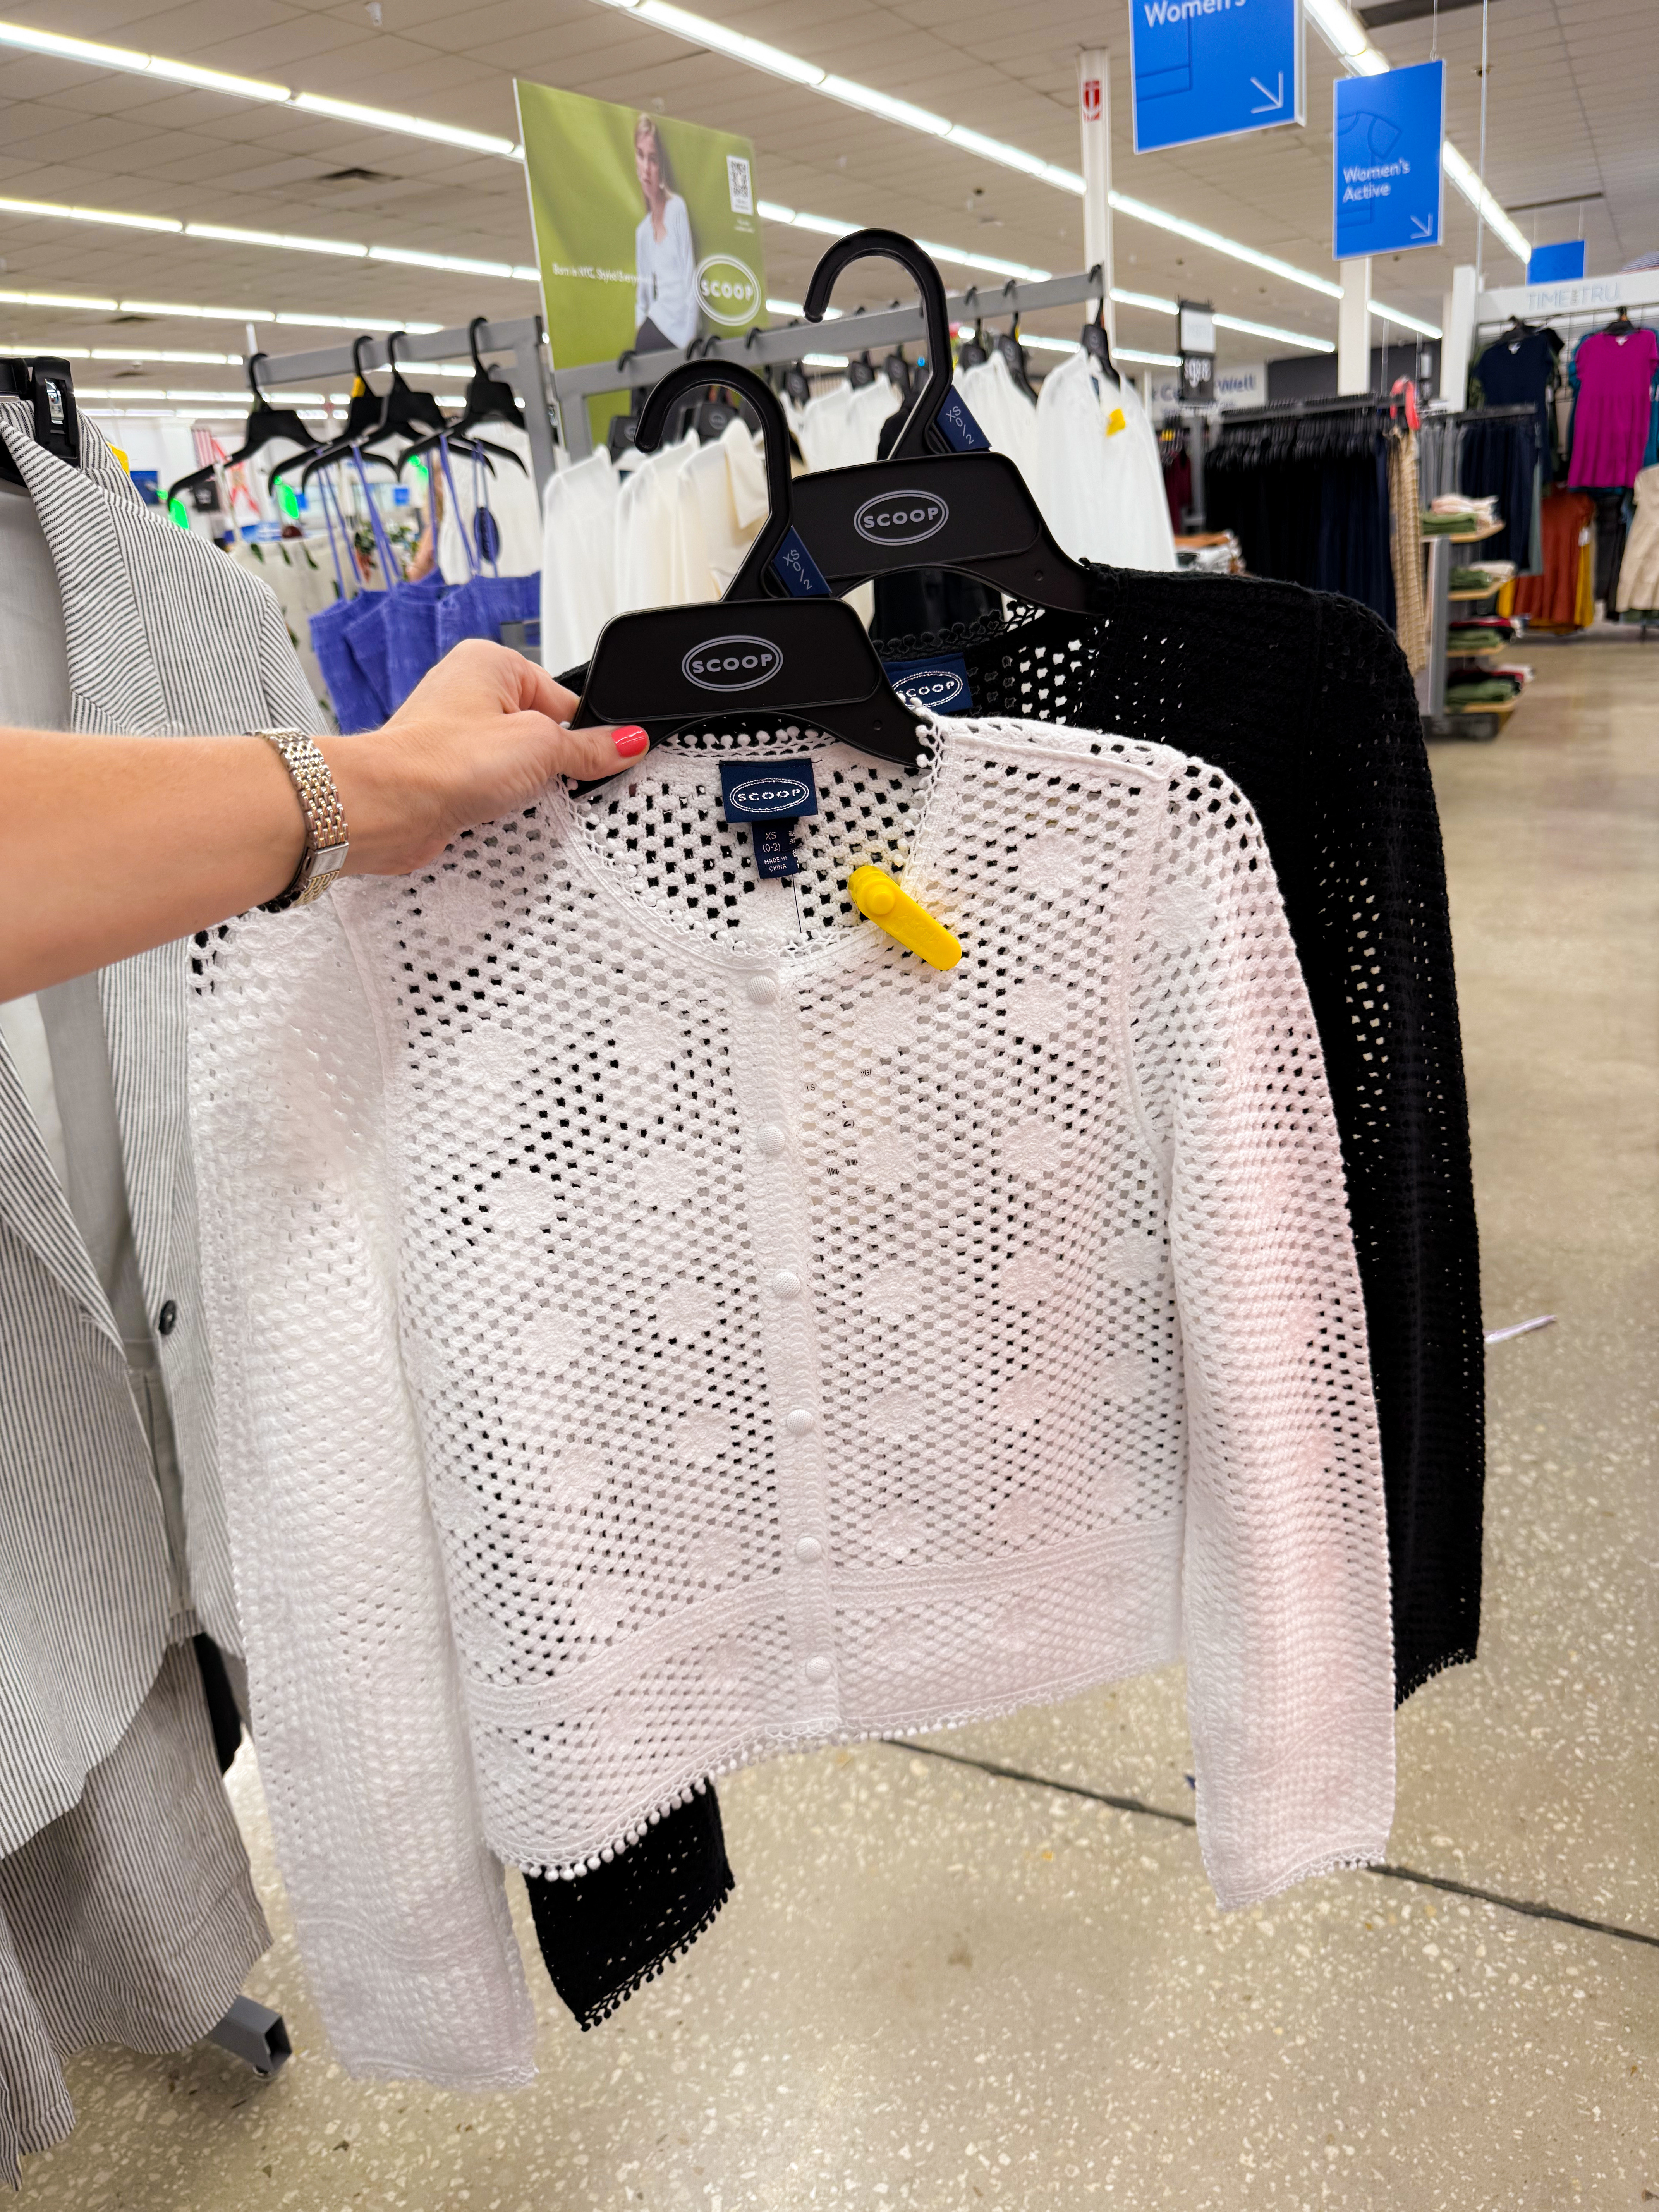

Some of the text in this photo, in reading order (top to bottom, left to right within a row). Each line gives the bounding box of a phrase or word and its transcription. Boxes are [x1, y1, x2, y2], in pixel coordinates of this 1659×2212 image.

[1343, 157, 1411, 183] Women's
[1342, 182, 1391, 204] Active
[700, 278, 754, 301] SCOOP
[1527, 289, 1570, 310] TIME
[1580, 282, 1619, 304] TRU
[946, 406, 961, 422] XS
[955, 417, 975, 445] 0/2
[863, 507, 939, 528] SCOOP
[783, 550, 800, 566] XS
[793, 562, 812, 590] 0/2
[692, 653, 773, 673] SCOOP
[738, 788, 801, 802] SCOOP
[765, 831, 776, 840] XS
[763, 842, 781, 853] (0-2)
[769, 863, 787, 872] CHINA
